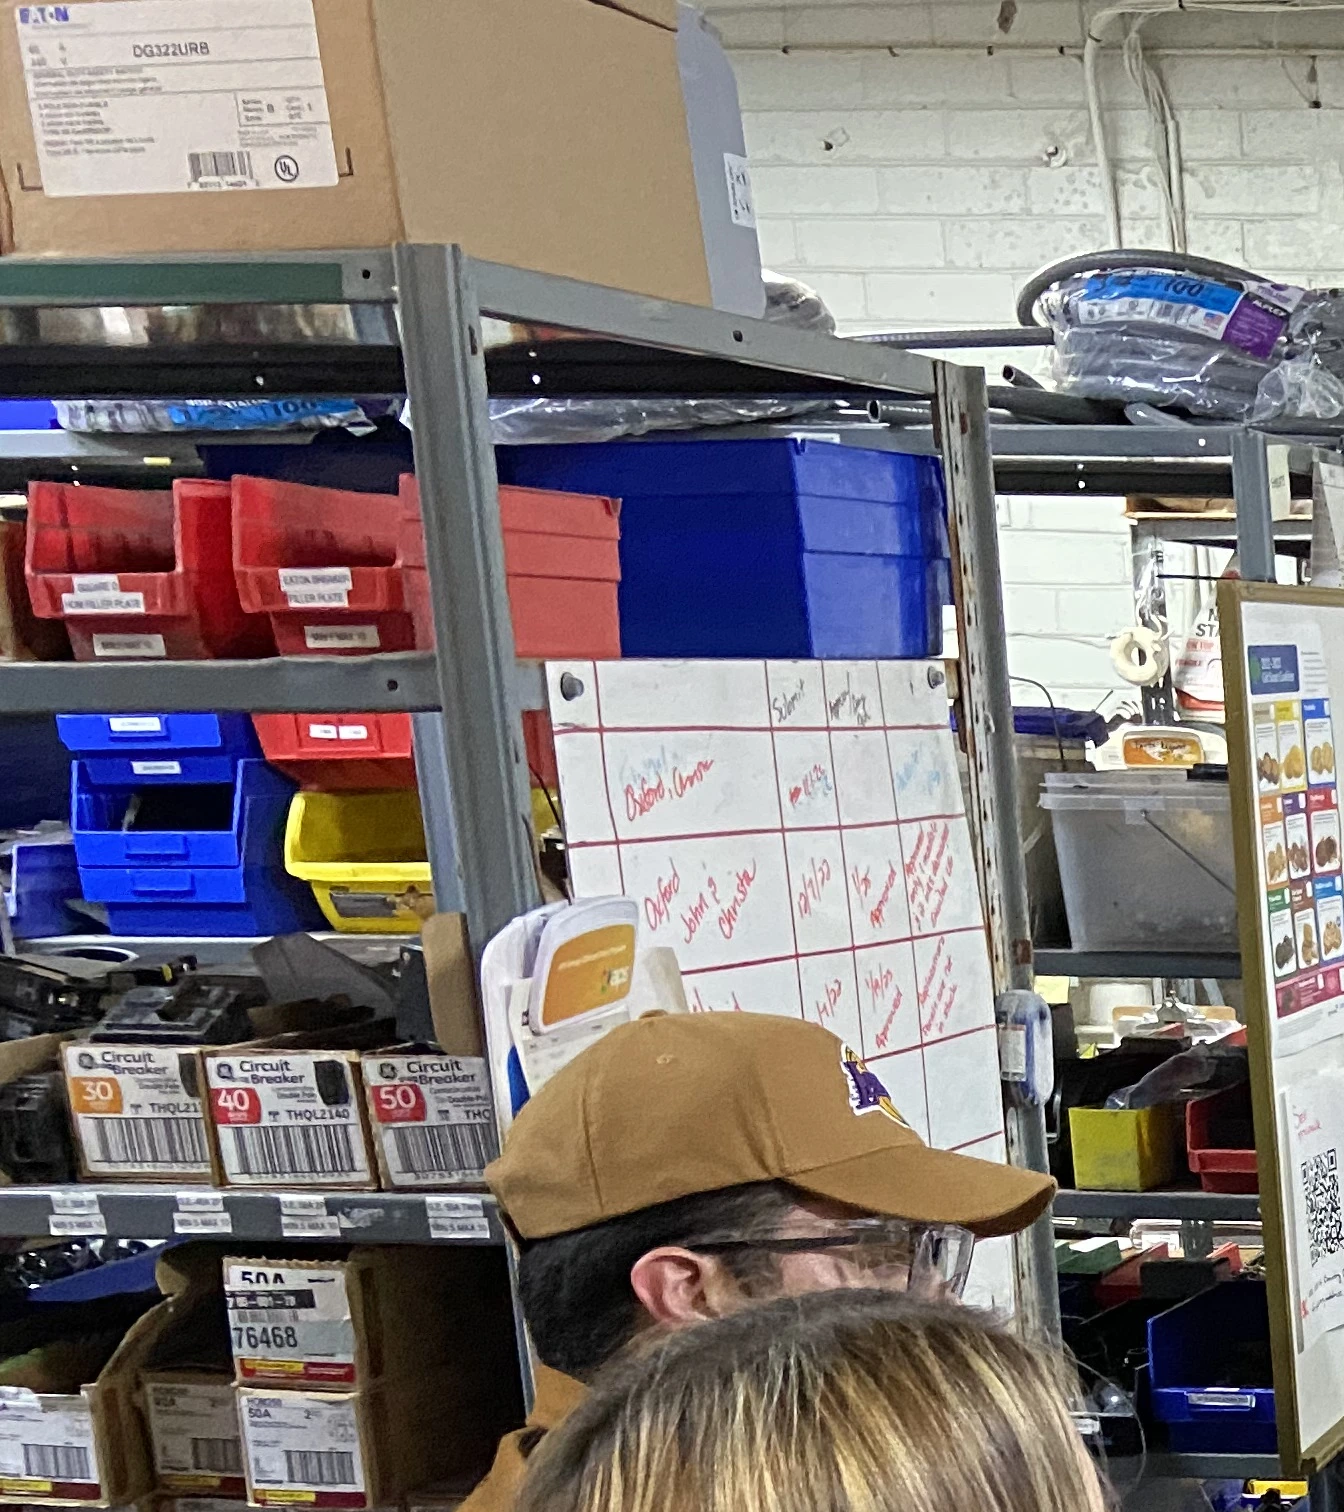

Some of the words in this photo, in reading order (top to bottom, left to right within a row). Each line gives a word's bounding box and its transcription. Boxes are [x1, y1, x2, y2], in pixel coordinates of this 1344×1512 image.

[133, 41, 210, 58] DG322URB
[644, 856, 681, 932] Oxford
[102, 1050, 156, 1063] Circuit
[113, 1063, 169, 1074] Breaker
[239, 1059, 292, 1072] Circuit
[407, 1060, 463, 1073] Circuit
[251, 1073, 306, 1085] Breaker
[419, 1072, 476, 1085] Breaker
[81, 1081, 114, 1101] 30
[380, 1085, 416, 1110] 50
[217, 1089, 250, 1112] 40
[149, 1102, 201, 1115] THQL21
[286, 1109, 350, 1121] THQL2140
[232, 1326, 298, 1349] 76468
